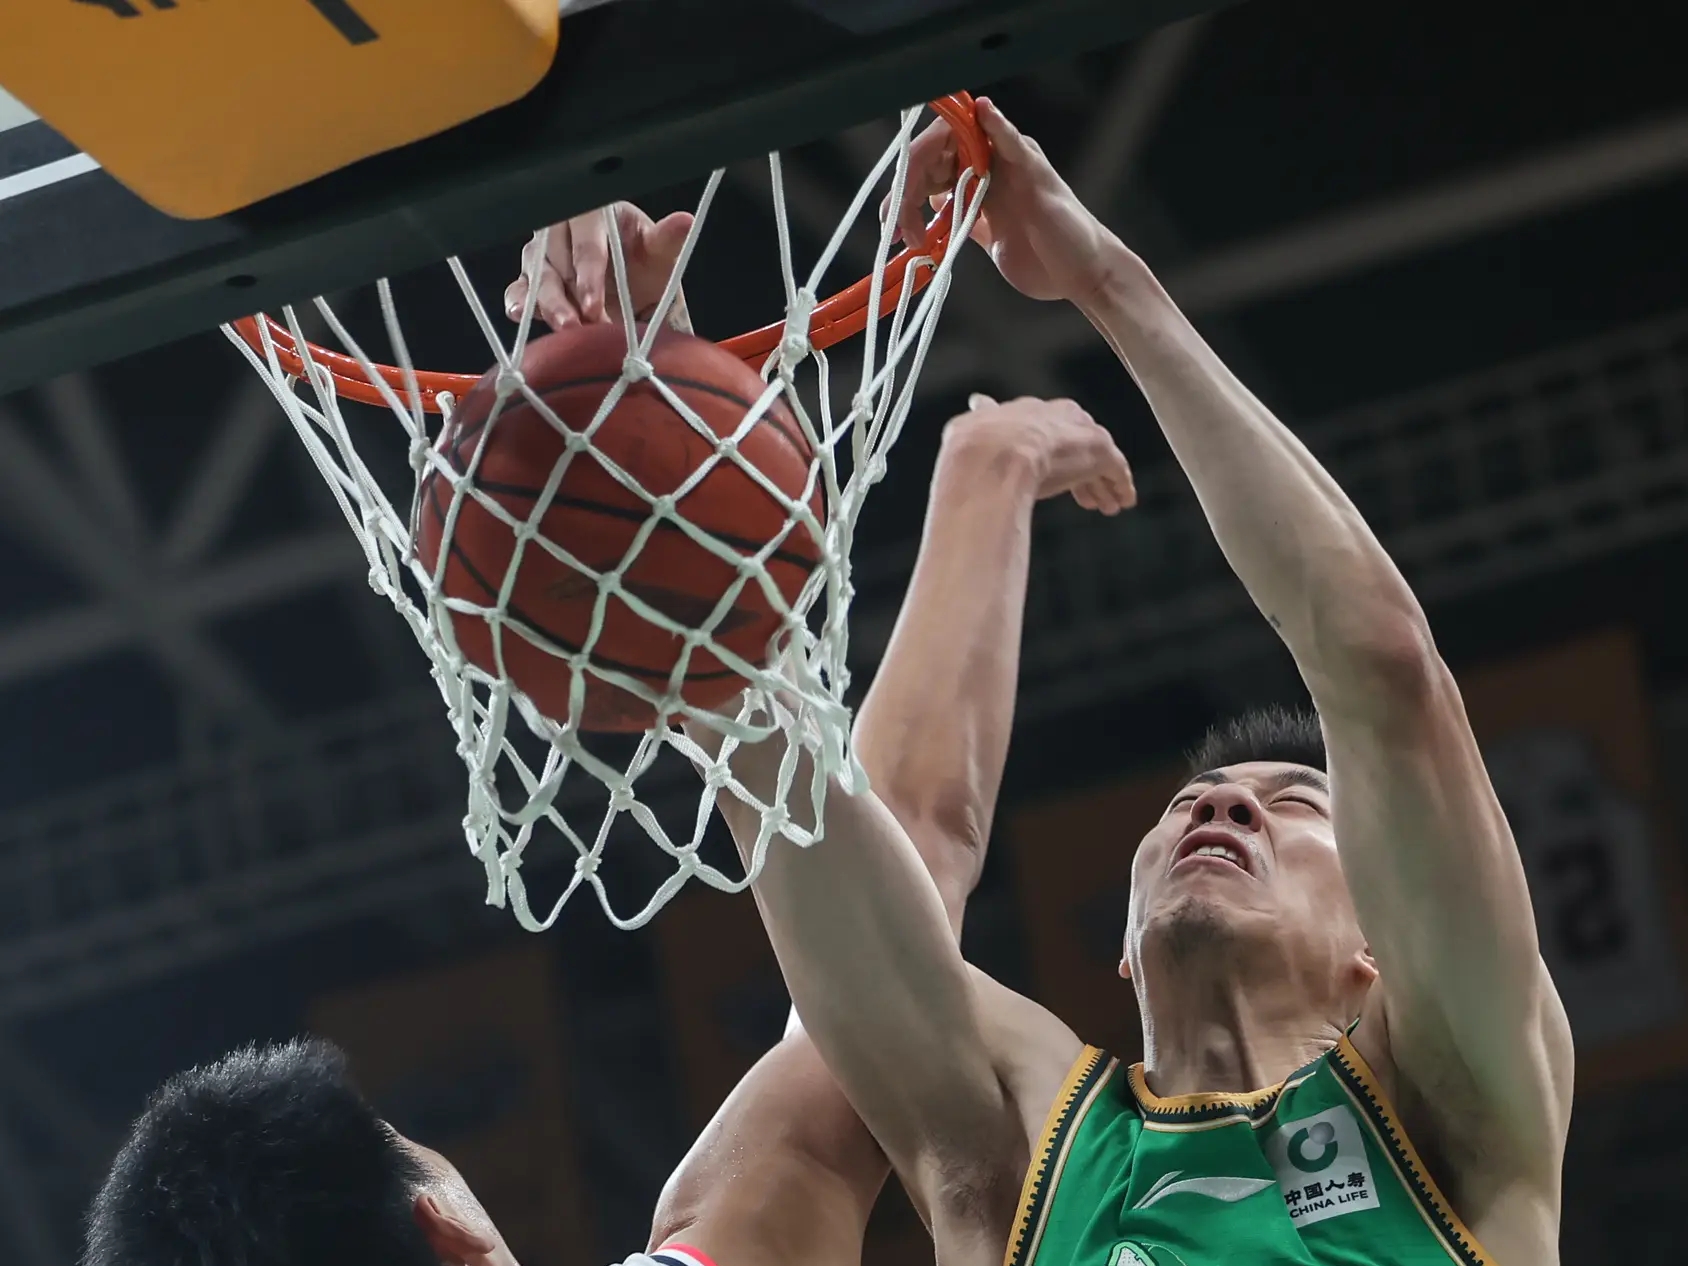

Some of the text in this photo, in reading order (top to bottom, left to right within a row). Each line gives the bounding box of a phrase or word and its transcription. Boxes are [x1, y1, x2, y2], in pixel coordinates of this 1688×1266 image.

[1284, 1172, 1365, 1206] 中国人寿
[1290, 1190, 1369, 1218] CHINA LIFE
